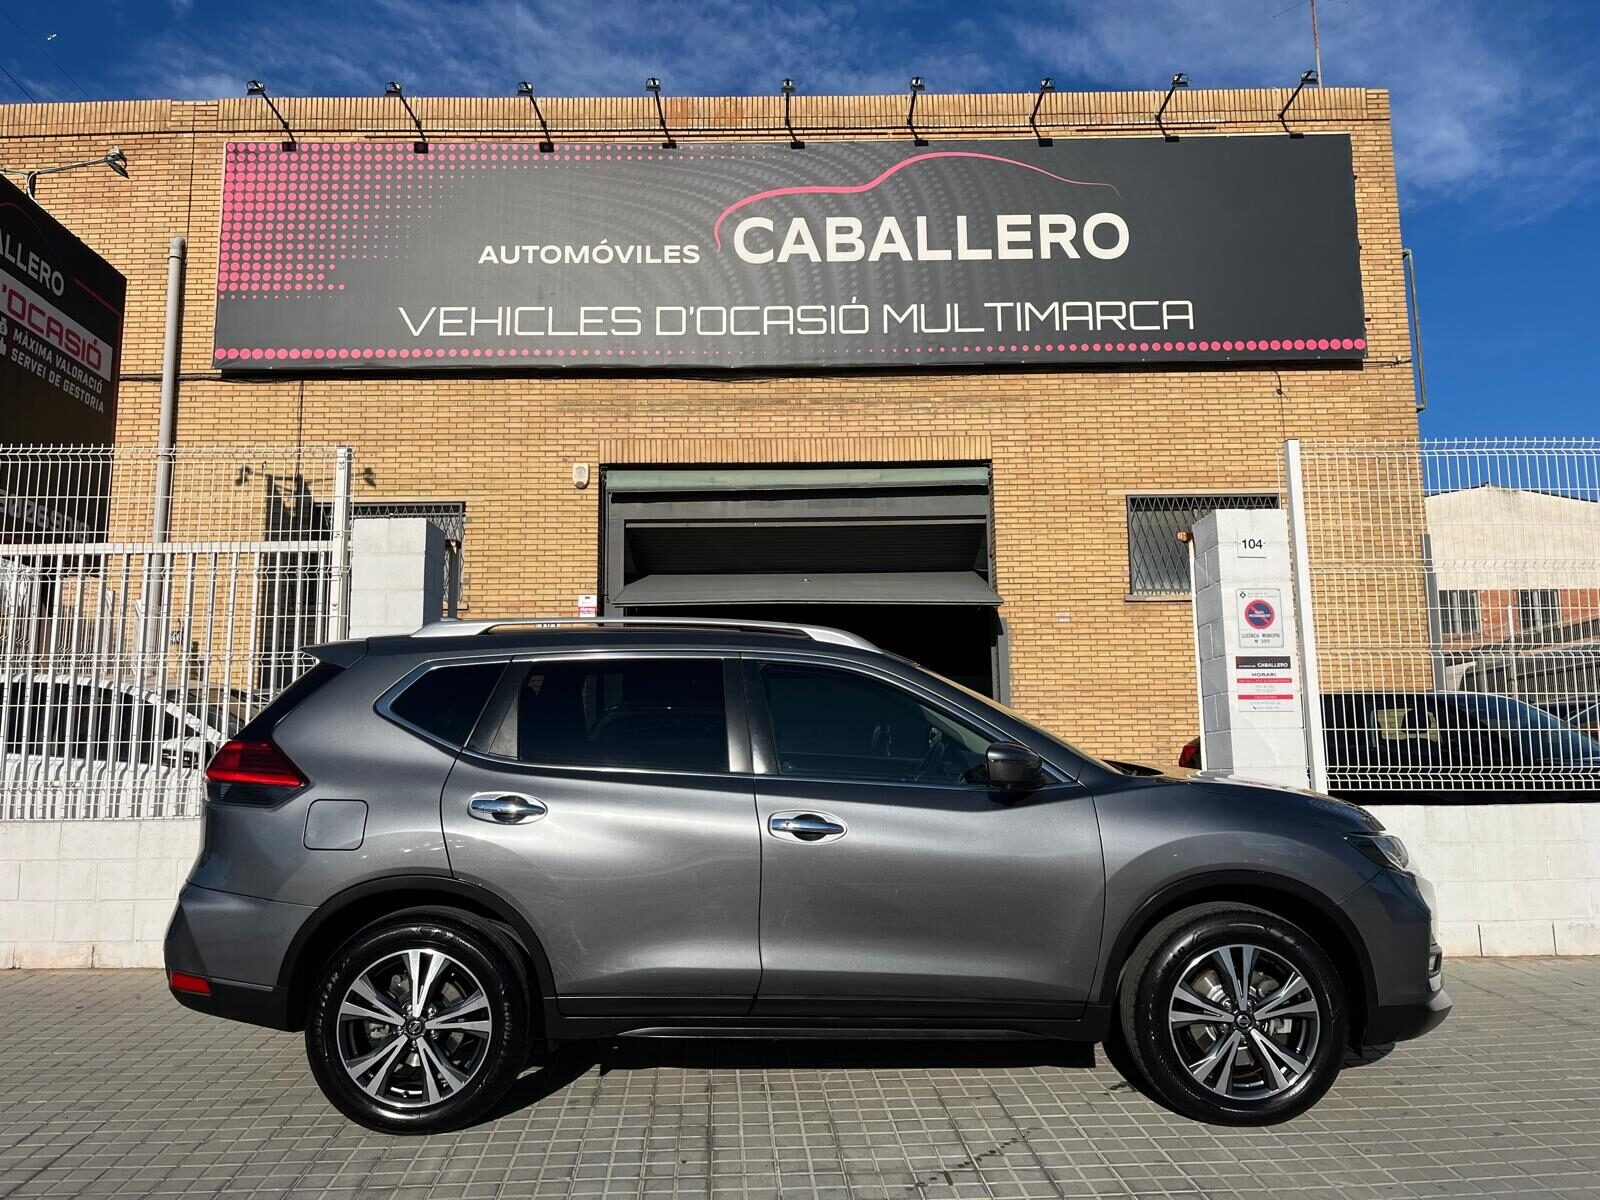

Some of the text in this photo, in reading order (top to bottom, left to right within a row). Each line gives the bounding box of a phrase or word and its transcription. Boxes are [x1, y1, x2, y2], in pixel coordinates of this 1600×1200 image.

[478, 212, 1130, 265] AUTOMÓVILES CABALLERO
[398, 297, 1195, 337] VEHICLES D'OCASIÓ MULTIMARCA
[11, 348, 104, 414] SERVEI DE GESTORIA
[55, 354, 103, 394] VALORACIÓ
[1241, 539, 1263, 549] 104
